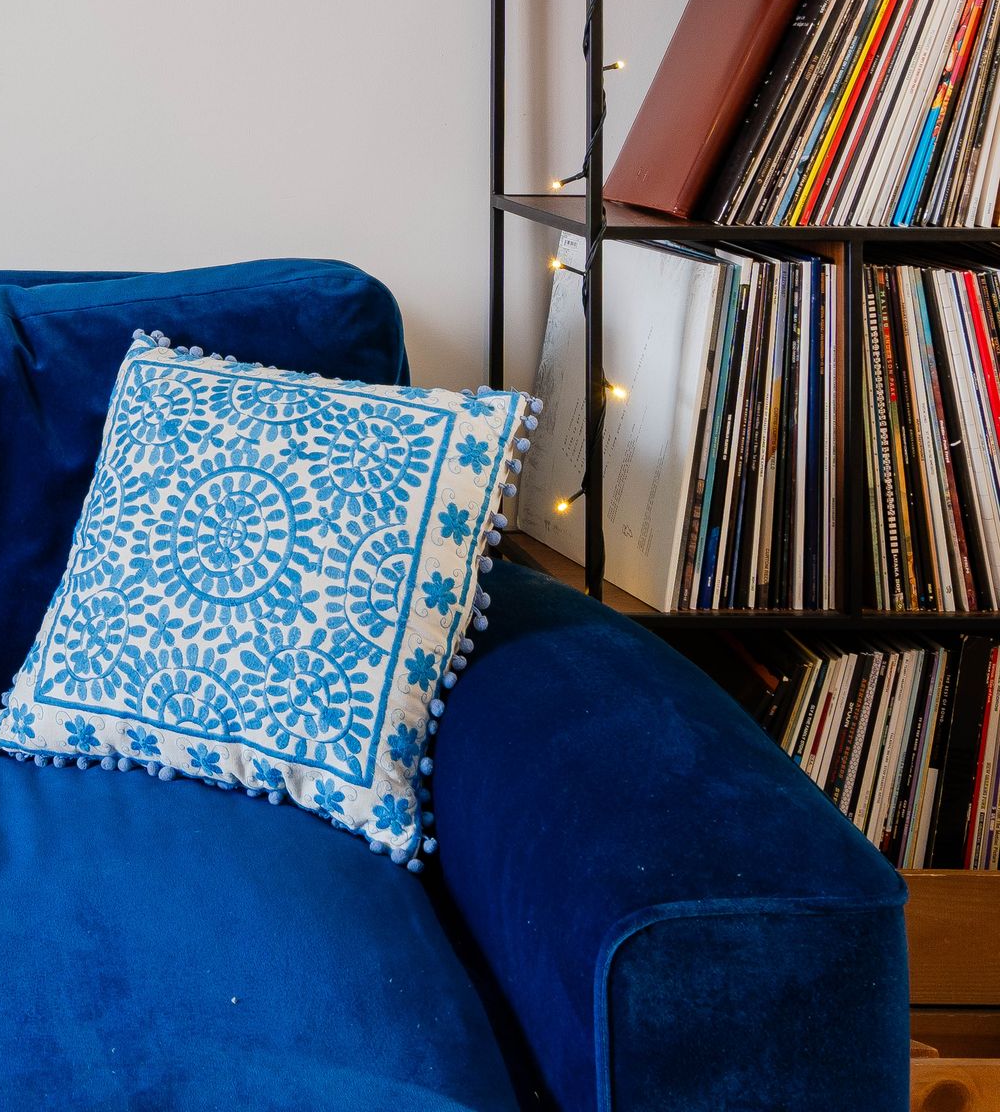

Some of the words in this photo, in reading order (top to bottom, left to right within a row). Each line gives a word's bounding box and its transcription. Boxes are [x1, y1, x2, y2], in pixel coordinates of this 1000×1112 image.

[804, 63, 814, 80] MELODY
[879, 291, 888, 328] MALIBU
[884, 334, 893, 375] ANDERSON
[808, 703, 816, 713] SLY
[804, 716, 812, 725] THE
[799, 724, 810, 740] FAMILY
[846, 721, 856, 744] KITTY
